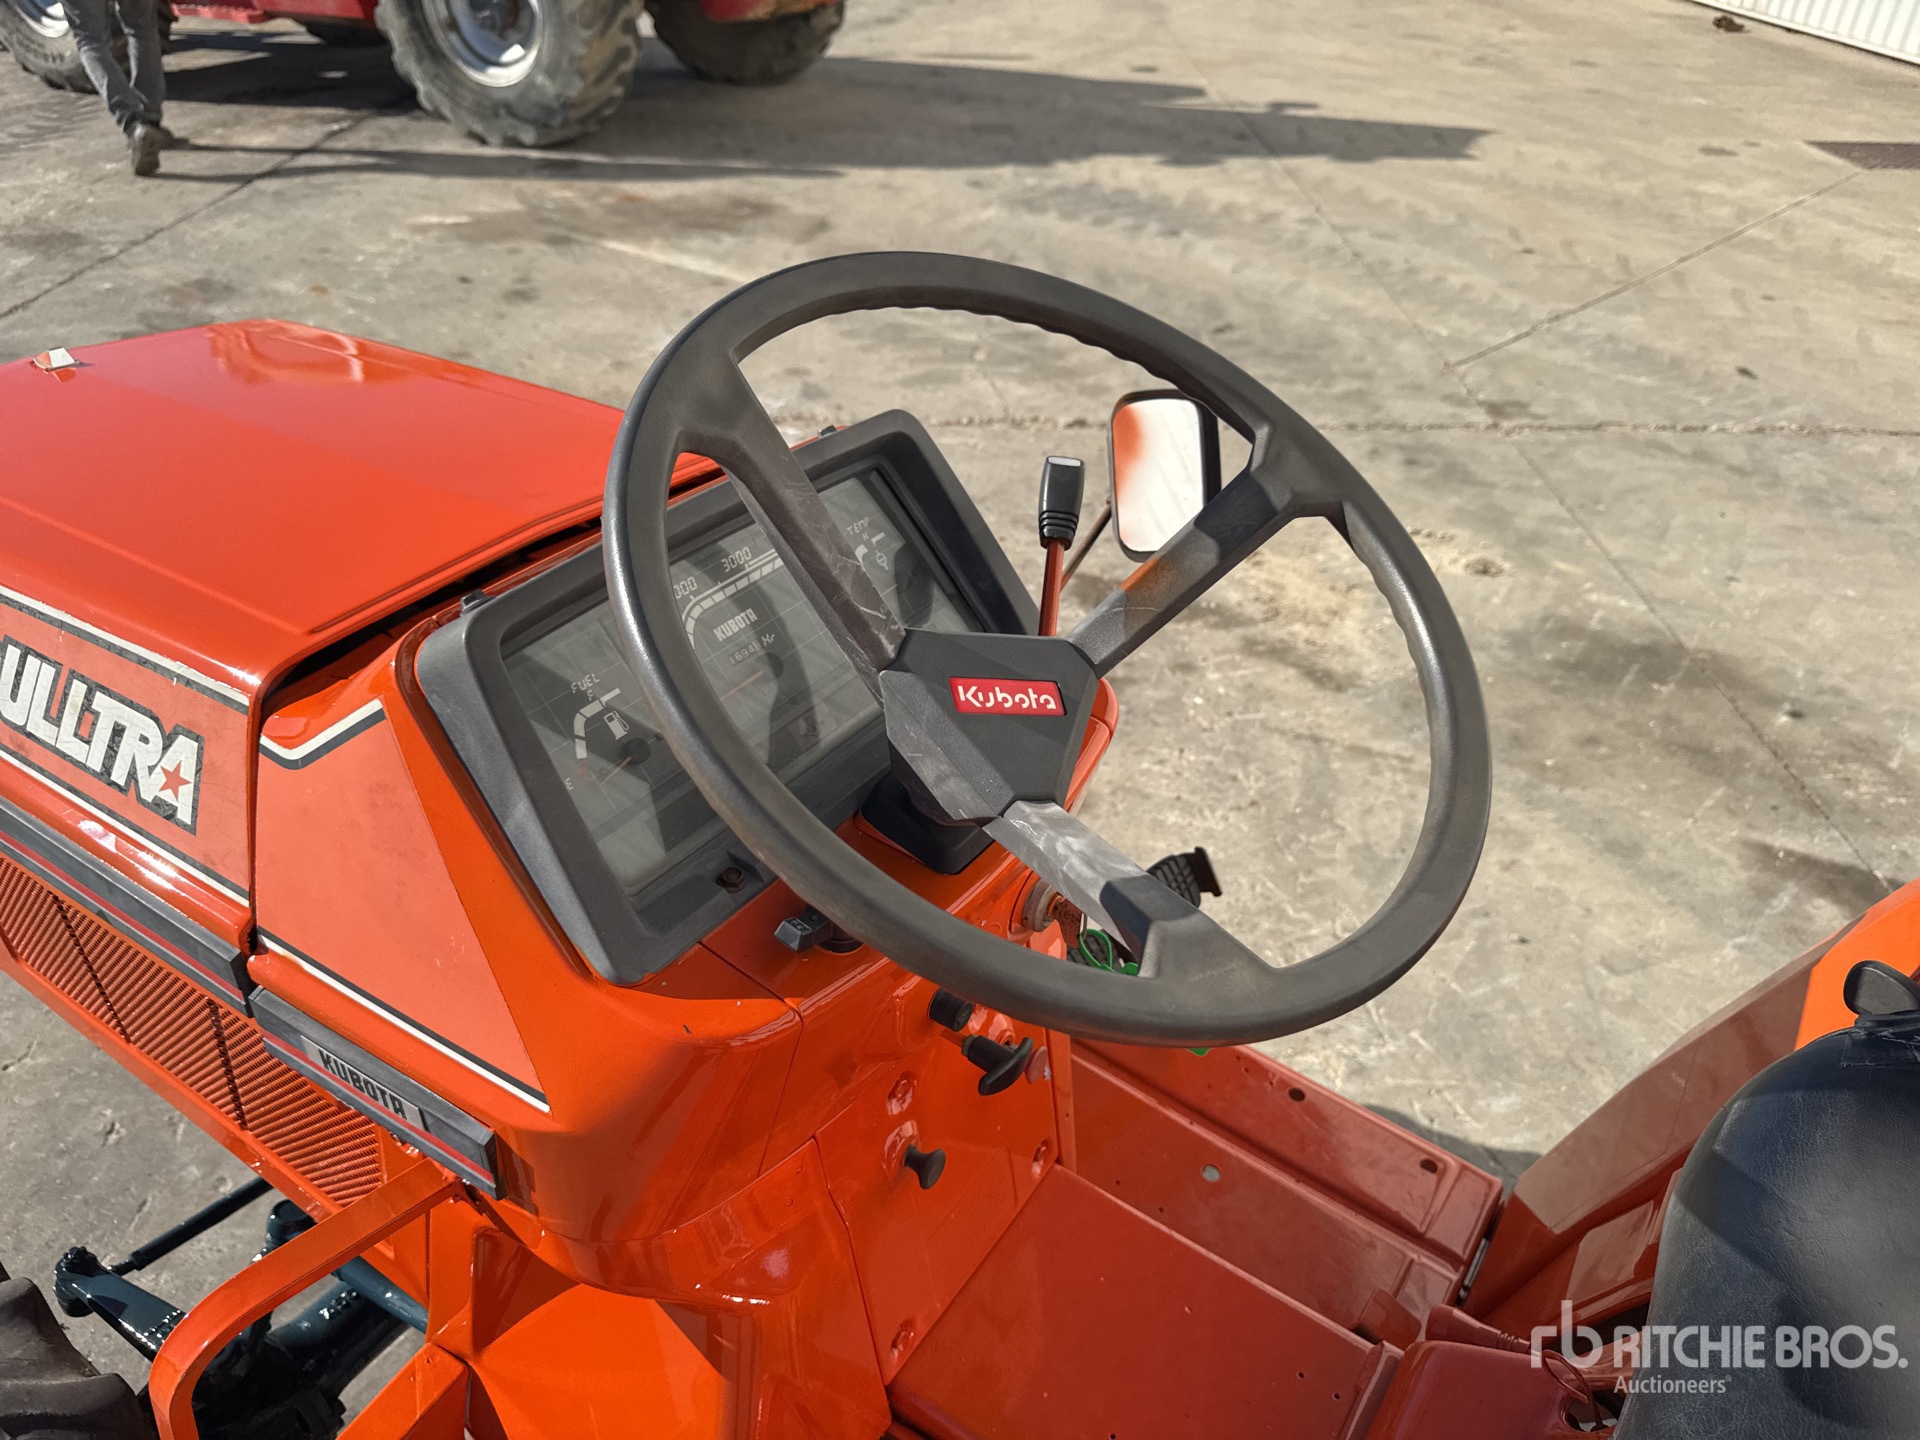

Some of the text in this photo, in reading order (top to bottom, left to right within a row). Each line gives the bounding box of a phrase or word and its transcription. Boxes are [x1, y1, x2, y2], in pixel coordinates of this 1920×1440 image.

[846, 517, 870, 536] TEMP
[721, 546, 752, 573] 3000
[713, 608, 758, 642] KUBOTA
[570, 673, 600, 694] FUEL
[957, 685, 1057, 710] Kubota
[318, 1048, 408, 1121] KUBOTA
